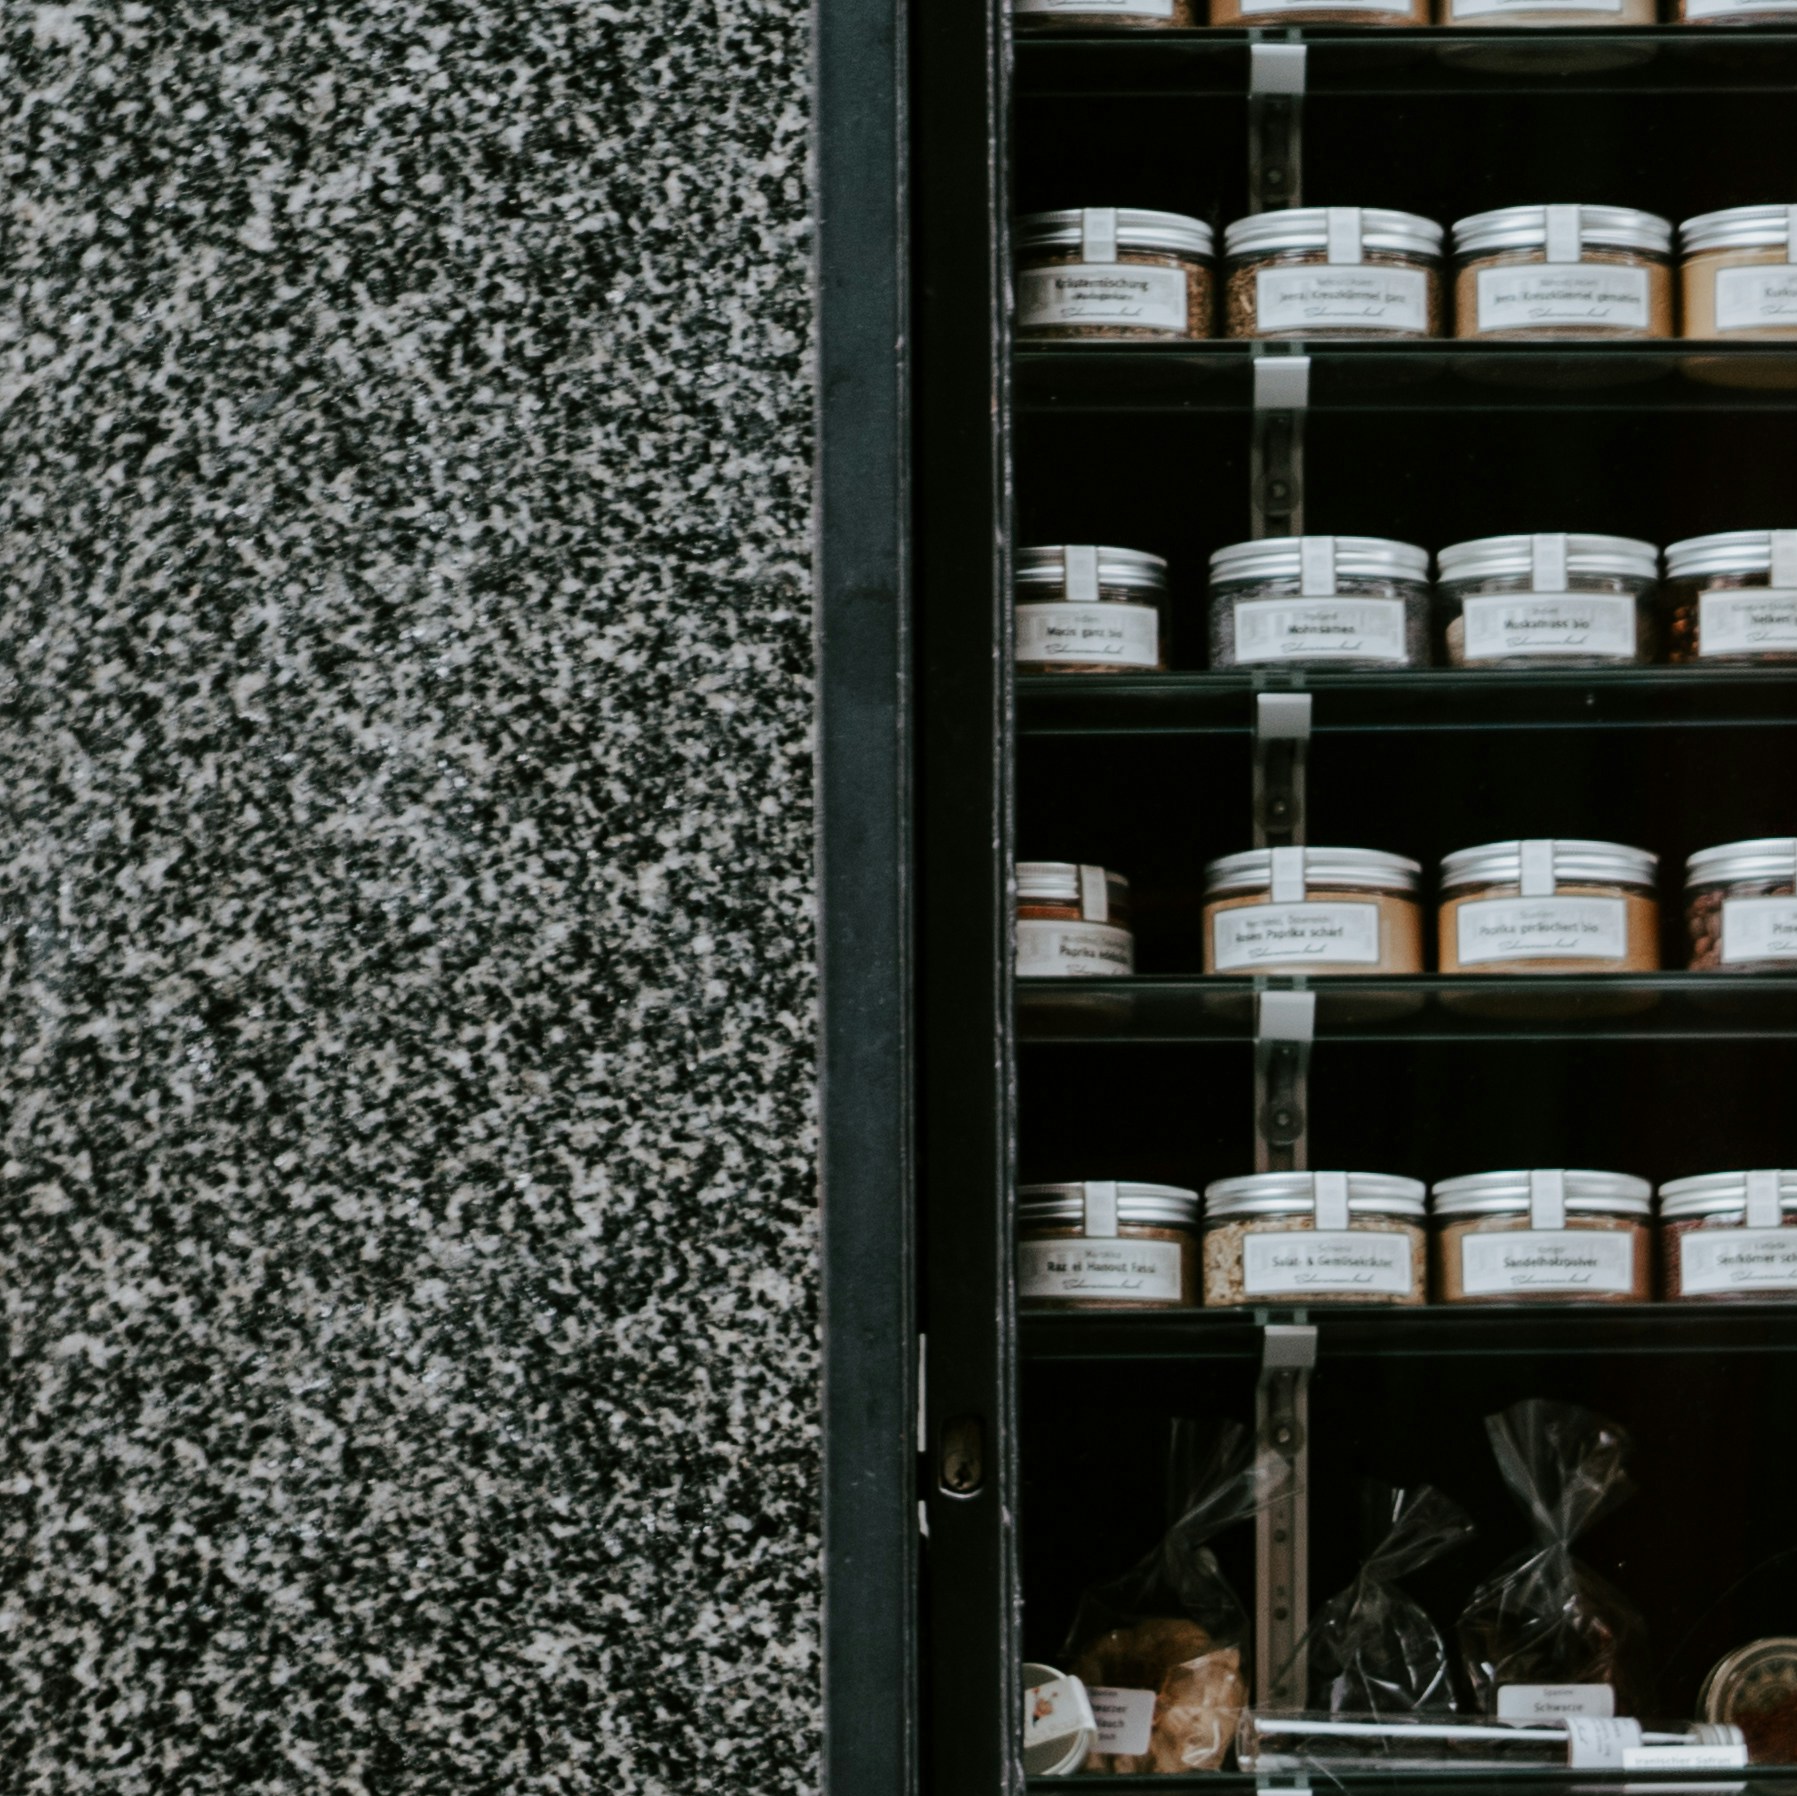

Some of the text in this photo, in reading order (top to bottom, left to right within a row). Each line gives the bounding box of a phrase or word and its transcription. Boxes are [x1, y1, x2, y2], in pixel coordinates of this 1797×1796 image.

[1287, 624, 1355, 634] Mohnsamen
[1504, 618, 1590, 630] Muskatnuss bio
[1266, 928, 1305, 941] Paprika
[1310, 928, 1343, 937] scharf
[1479, 922, 1599, 936] Paprika geräuchert bio
[1503, 1257, 1598, 1268] Sandelholzpulver
[1717, 1254, 1775, 1265] Senfkörner
[1048, 1262, 1156, 1273] Raz el Hanout Fassi
[1534, 1703, 1583, 1712] Schwarze
